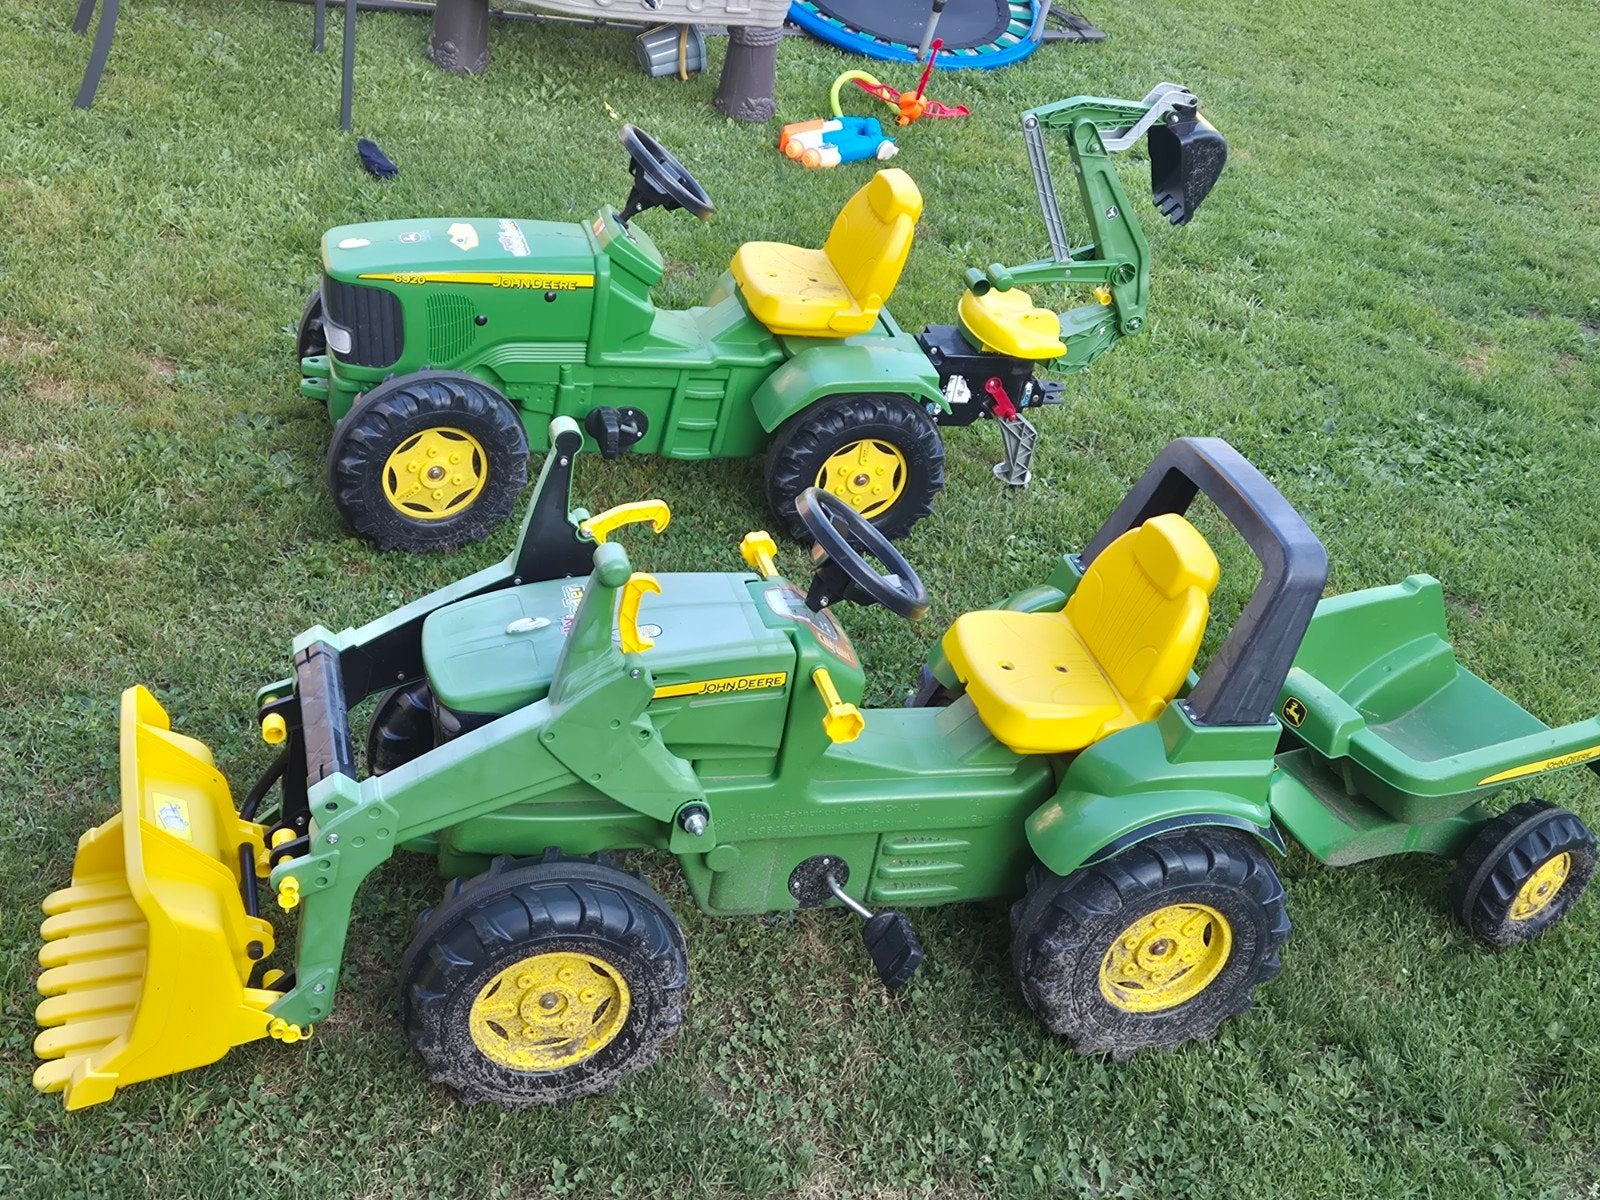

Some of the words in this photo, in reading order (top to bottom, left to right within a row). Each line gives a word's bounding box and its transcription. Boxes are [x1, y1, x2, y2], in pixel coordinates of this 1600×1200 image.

[394, 274, 426, 286] 6920
[492, 274, 530, 289] JOHN
[531, 278, 578, 291] DEERE
[700, 683, 735, 694] JOHN
[737, 677, 782, 689] DEERE
